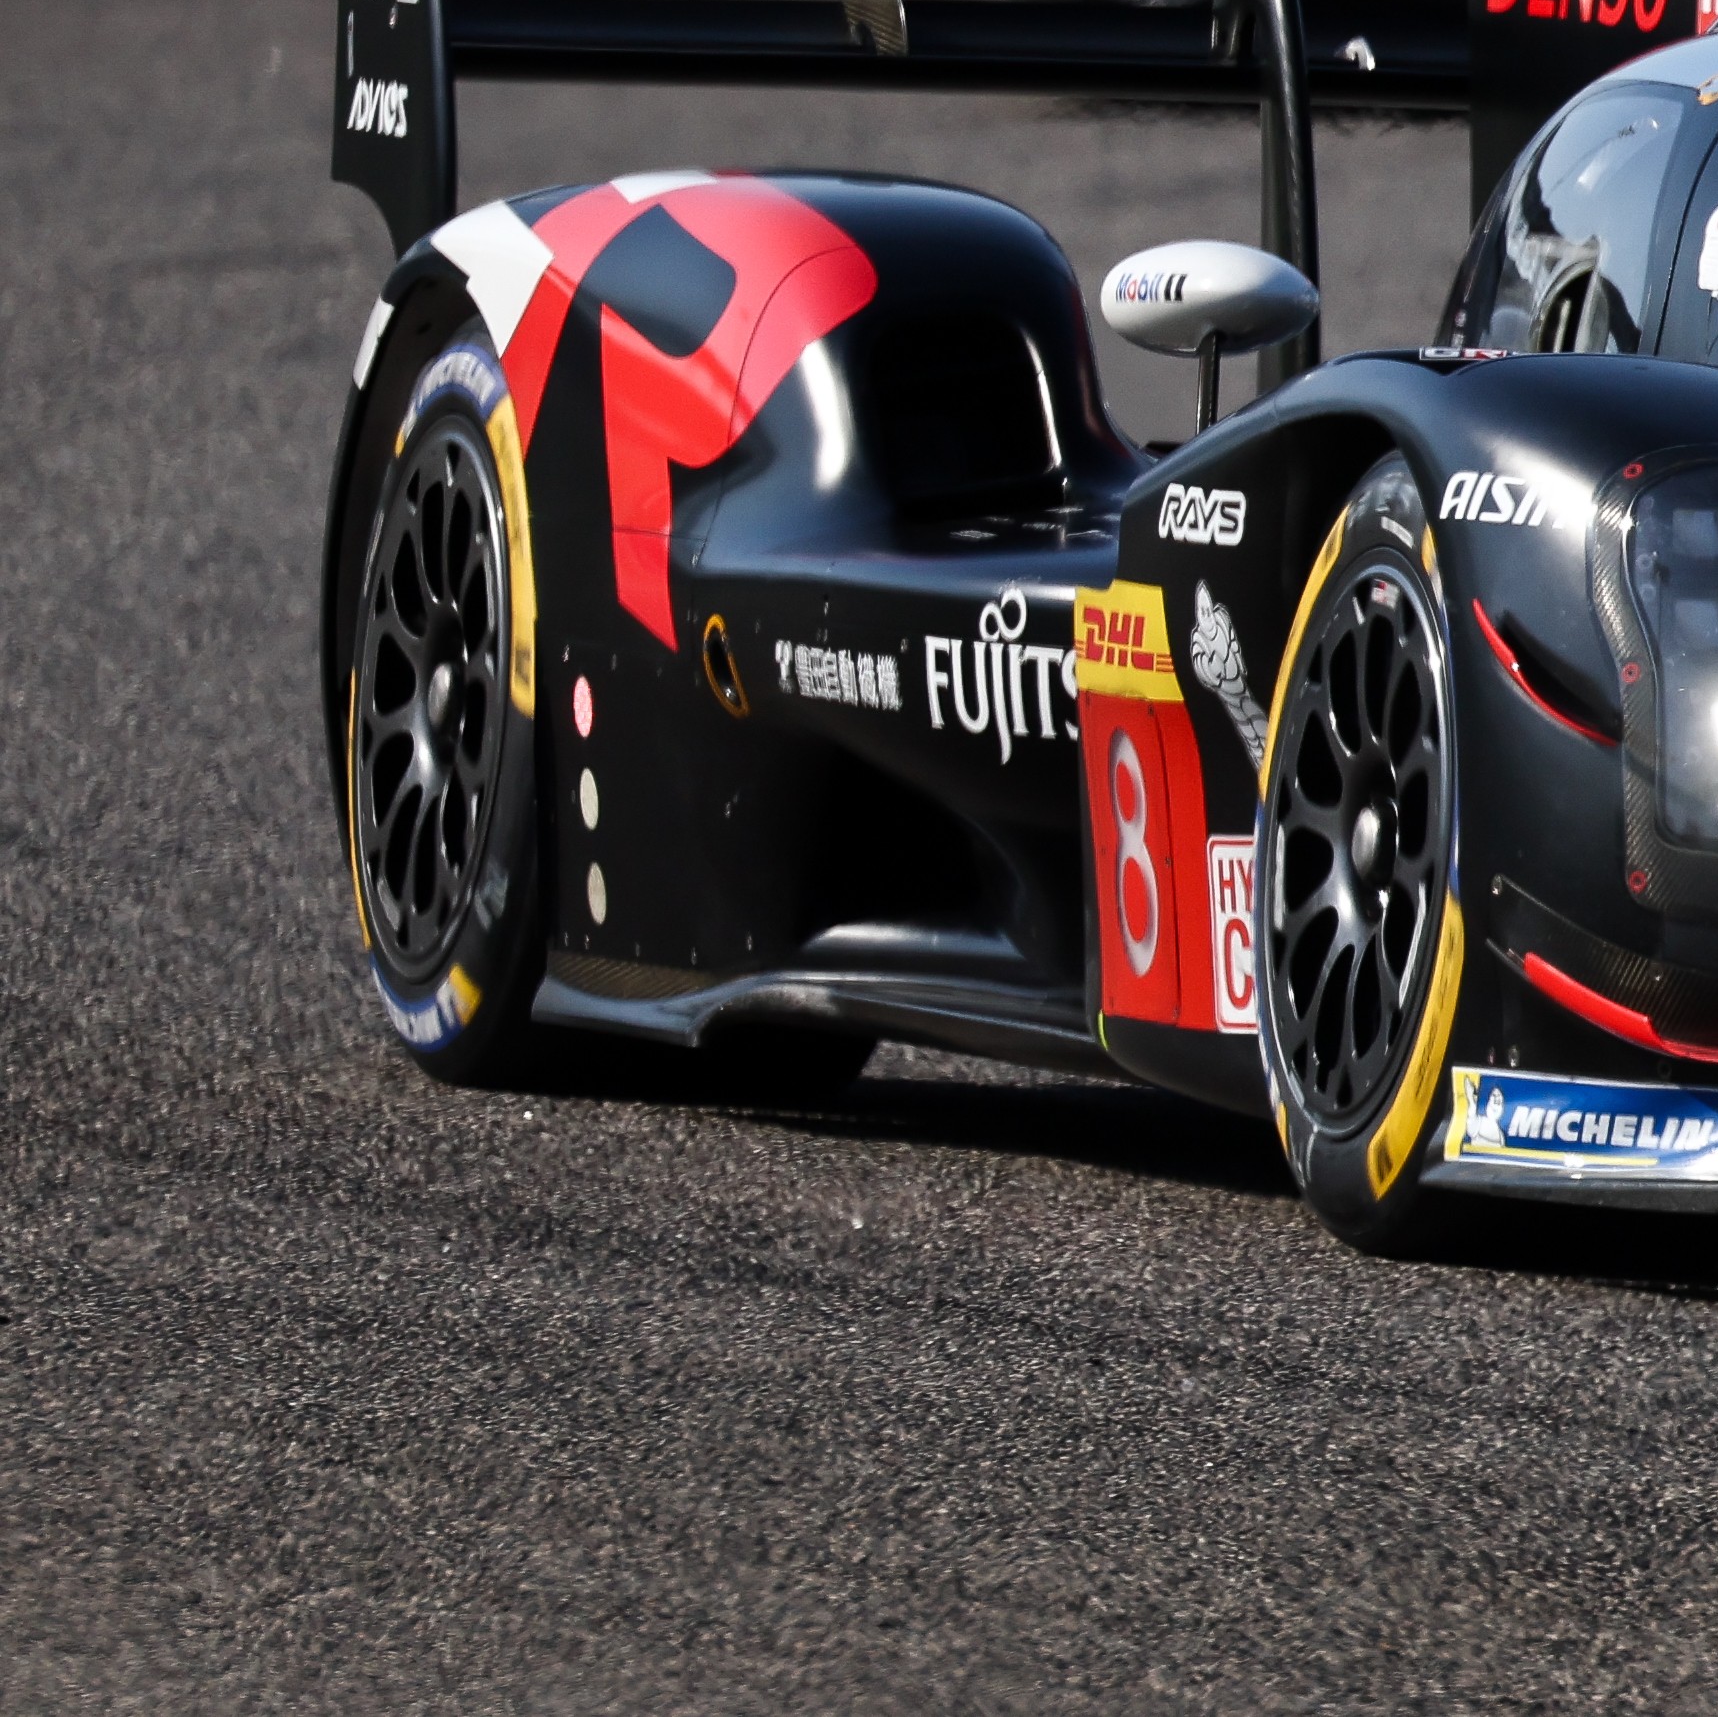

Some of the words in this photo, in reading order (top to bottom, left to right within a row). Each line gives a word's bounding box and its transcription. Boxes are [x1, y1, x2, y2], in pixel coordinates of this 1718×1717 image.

[1115, 272, 1164, 302] Mobil
[1160, 483, 1246, 547] RAYS
[1083, 607, 1156, 673] DHL
[1108, 727, 1160, 979] 8
[1507, 1104, 1716, 1151] MICHELIN
